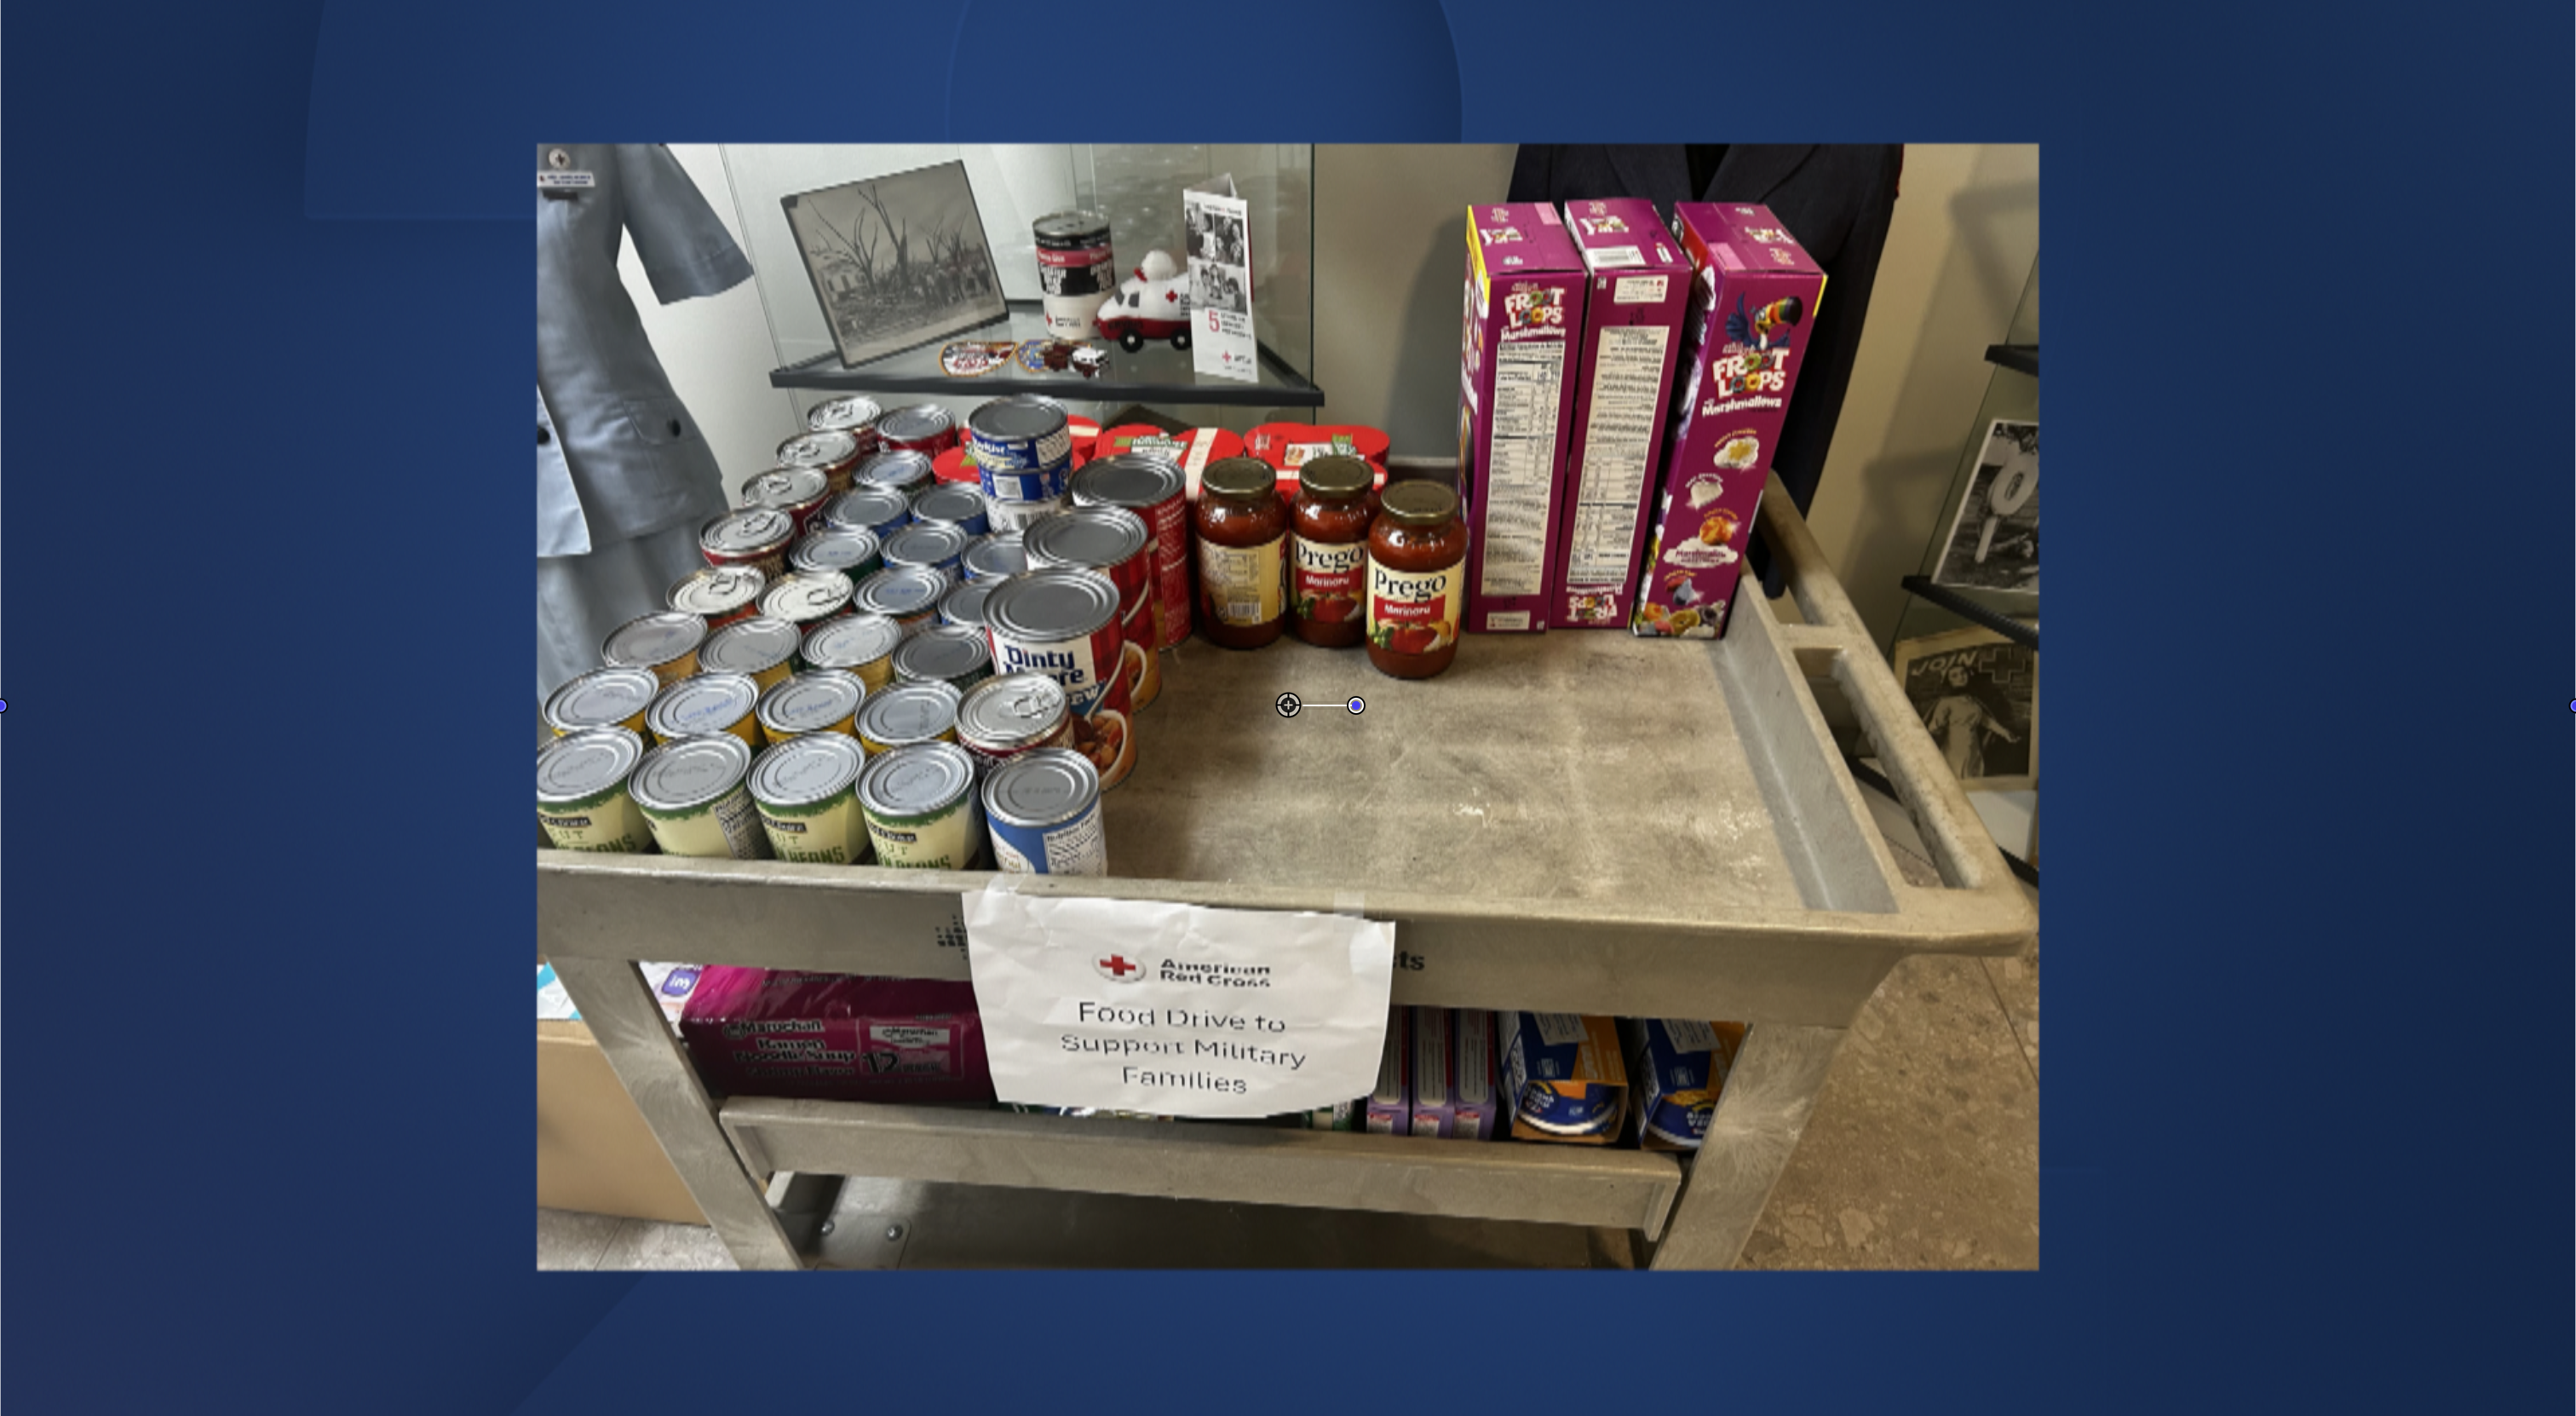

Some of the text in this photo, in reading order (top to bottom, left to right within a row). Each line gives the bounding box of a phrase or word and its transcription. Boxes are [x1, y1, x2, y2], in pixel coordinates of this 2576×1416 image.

[1504, 287, 1565, 316] FROOT
[1209, 310, 1221, 332] 5
[1509, 307, 1563, 329] LOOPS
[1713, 348, 1790, 383] FROOT
[1718, 371, 1786, 399] LOOPS
[1296, 541, 1363, 573] Prego
[1305, 574, 1349, 588] Marinara
[1375, 567, 1446, 603] Prego
[1384, 603, 1431, 617] Marinara
[1003, 643, 1075, 670] Dinty
[1912, 650, 1978, 683] JOIN
[1160, 958, 1271, 976] American
[1160, 970, 1271, 987] Red Cross
[741, 1019, 825, 1034] Maruchan
[1078, 1001, 1285, 1033] Food Drive to
[756, 1038, 826, 1050] Ramen
[1061, 1033, 1306, 1070] Support Military
[1123, 1067, 1247, 1094] Families
